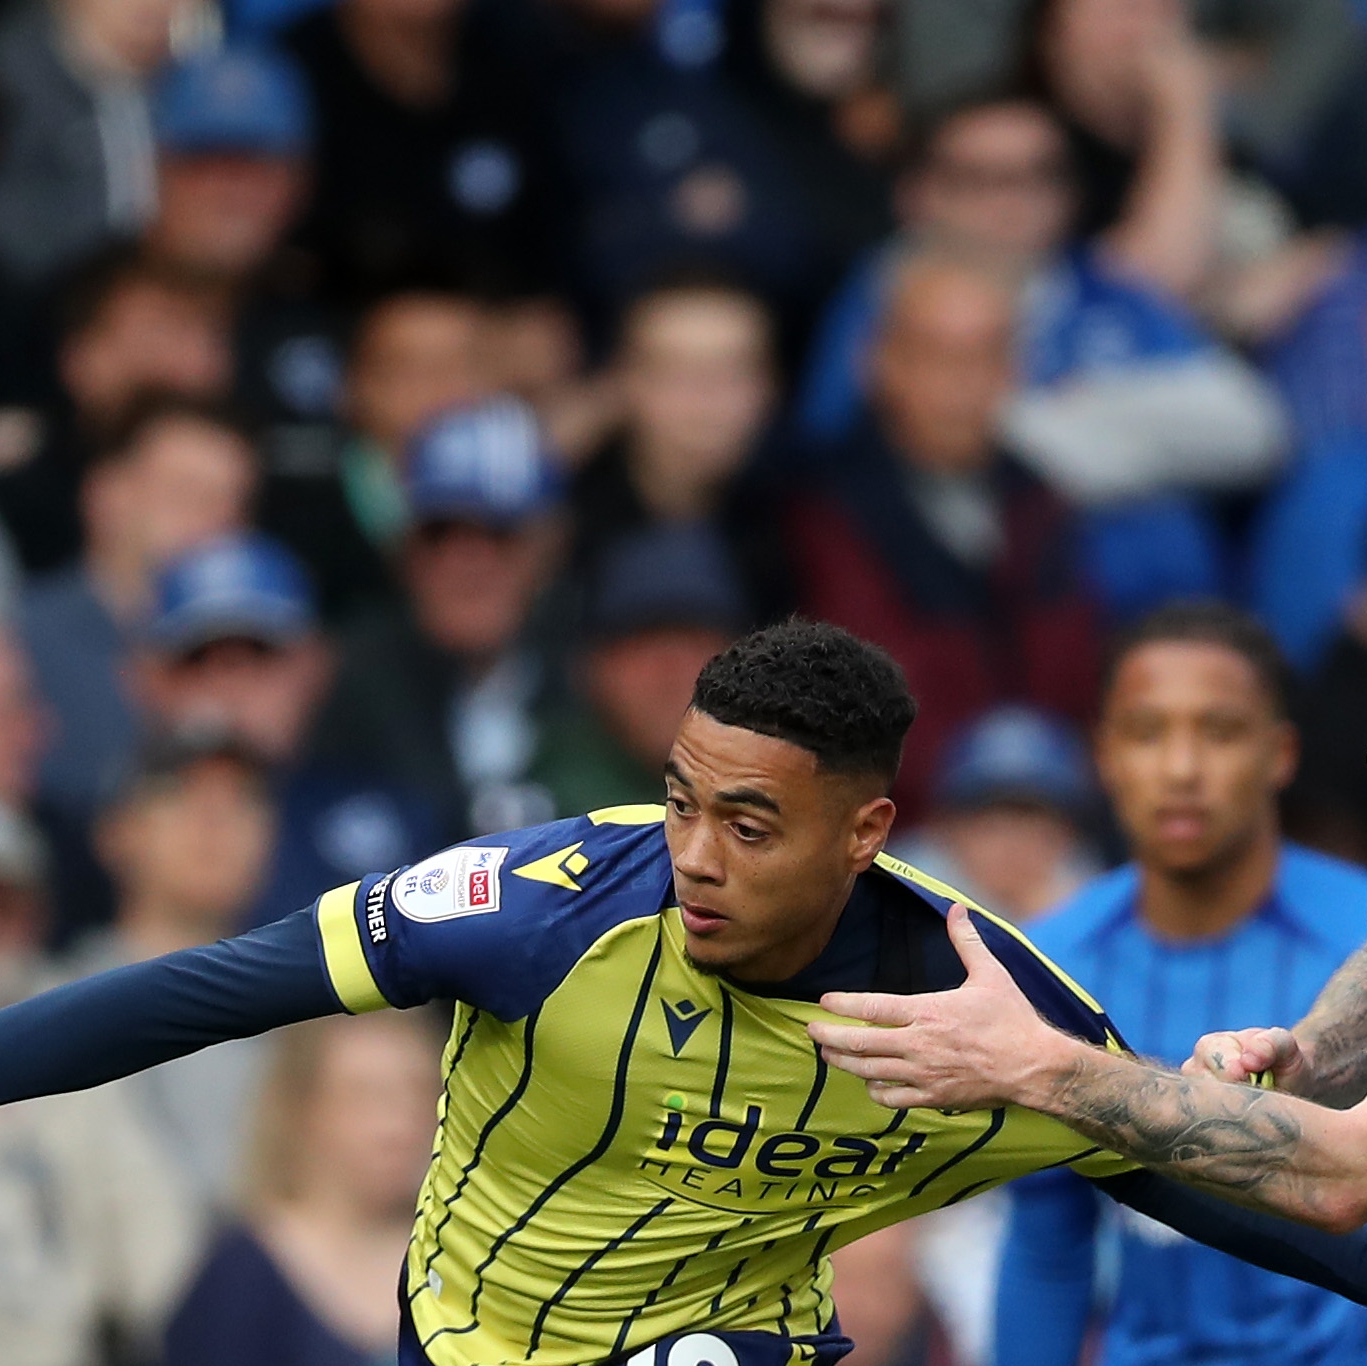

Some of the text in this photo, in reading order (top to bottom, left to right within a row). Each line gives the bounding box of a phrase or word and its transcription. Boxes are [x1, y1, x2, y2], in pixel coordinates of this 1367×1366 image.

[404, 875, 418, 897] EFL
[472, 871, 488, 903] bet
[655, 1095, 927, 1178] ideal
